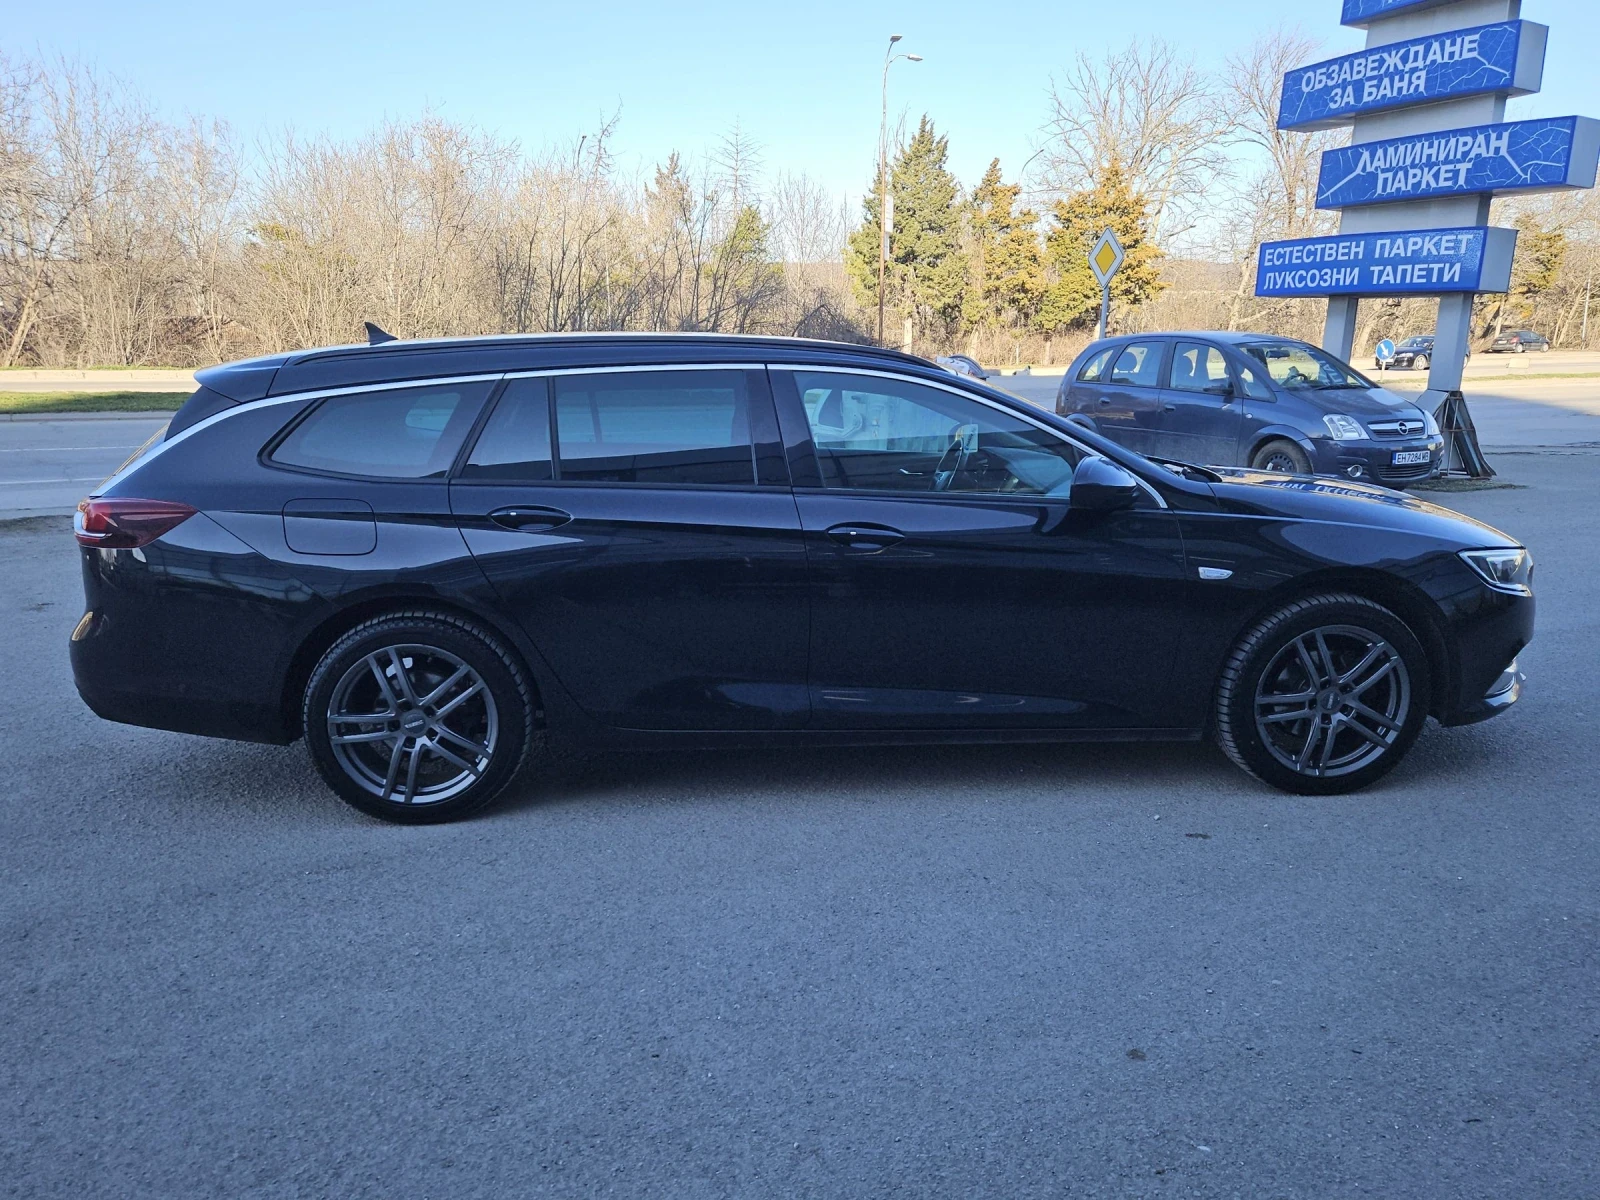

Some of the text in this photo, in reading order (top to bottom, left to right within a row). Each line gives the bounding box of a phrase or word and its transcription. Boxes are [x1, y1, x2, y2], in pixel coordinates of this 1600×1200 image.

[1301, 34, 1480, 92] ОБЗАВЕЖДАНЕ
[1329, 69, 1427, 109] ЗА БАНЯ
[1356, 130, 1510, 172] ЛАМИНИРАН
[1376, 162, 1473, 195] ПАРКЕТ
[1264, 234, 1474, 266] ЕСТЕСТВЕН ПАРКЕТ
[1263, 262, 1462, 290] ЛУКСОЗНИ ТАПЕТИ
